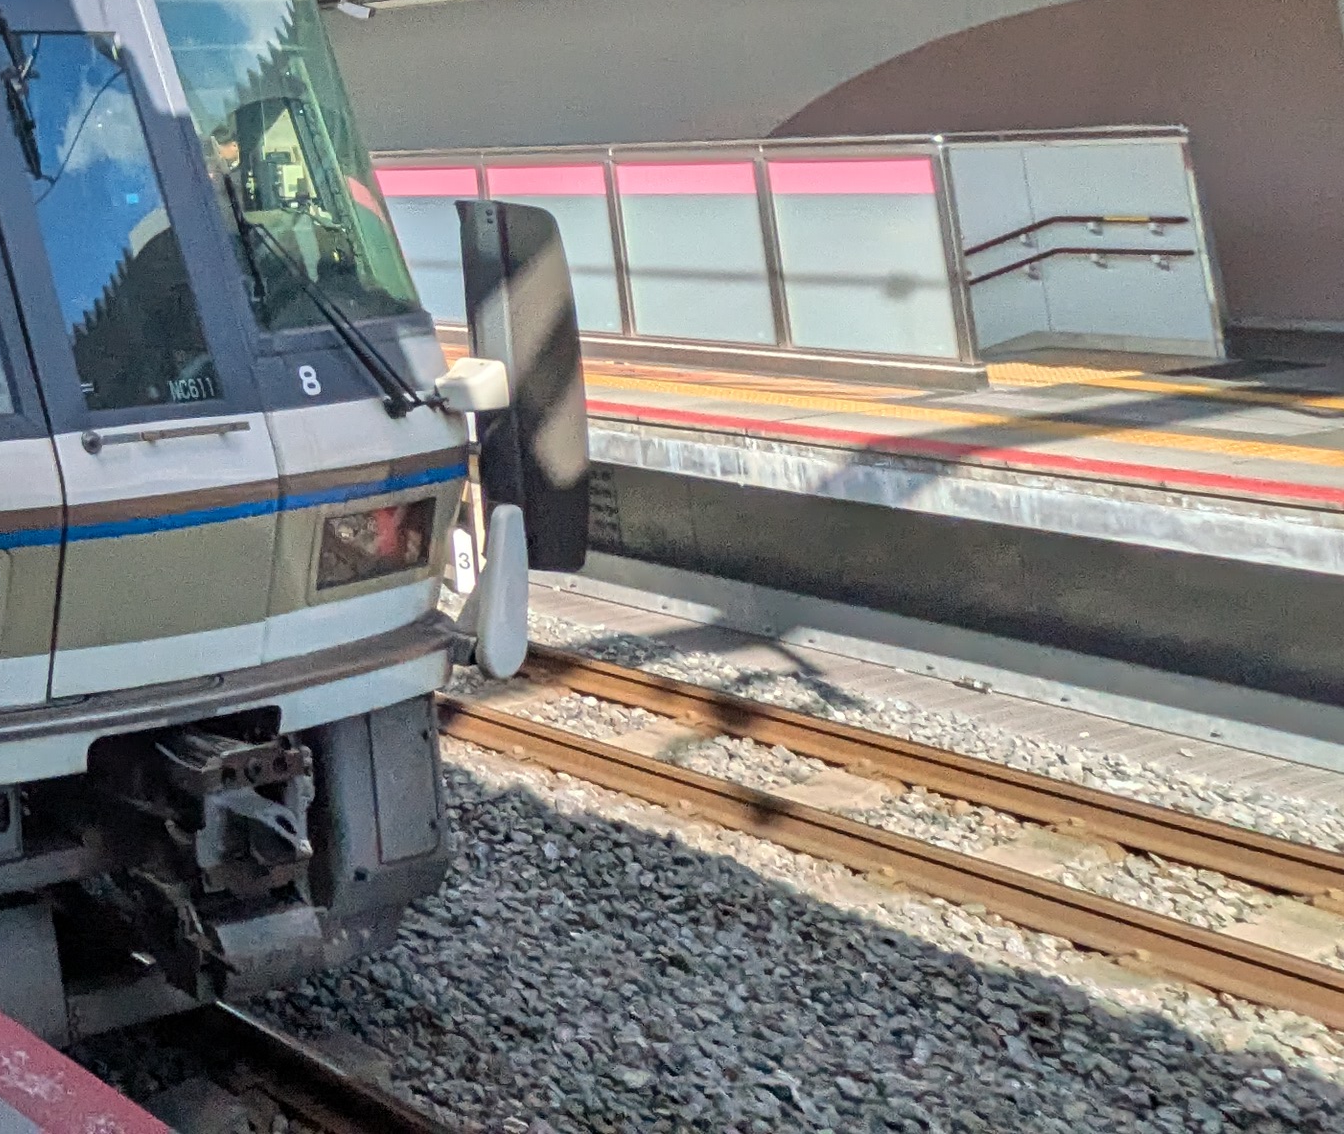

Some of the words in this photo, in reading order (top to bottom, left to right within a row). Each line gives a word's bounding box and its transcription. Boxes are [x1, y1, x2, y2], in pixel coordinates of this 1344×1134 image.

[167, 377, 216, 402] NC611
[298, 365, 322, 396] 8
[458, 552, 471, 570] 3
